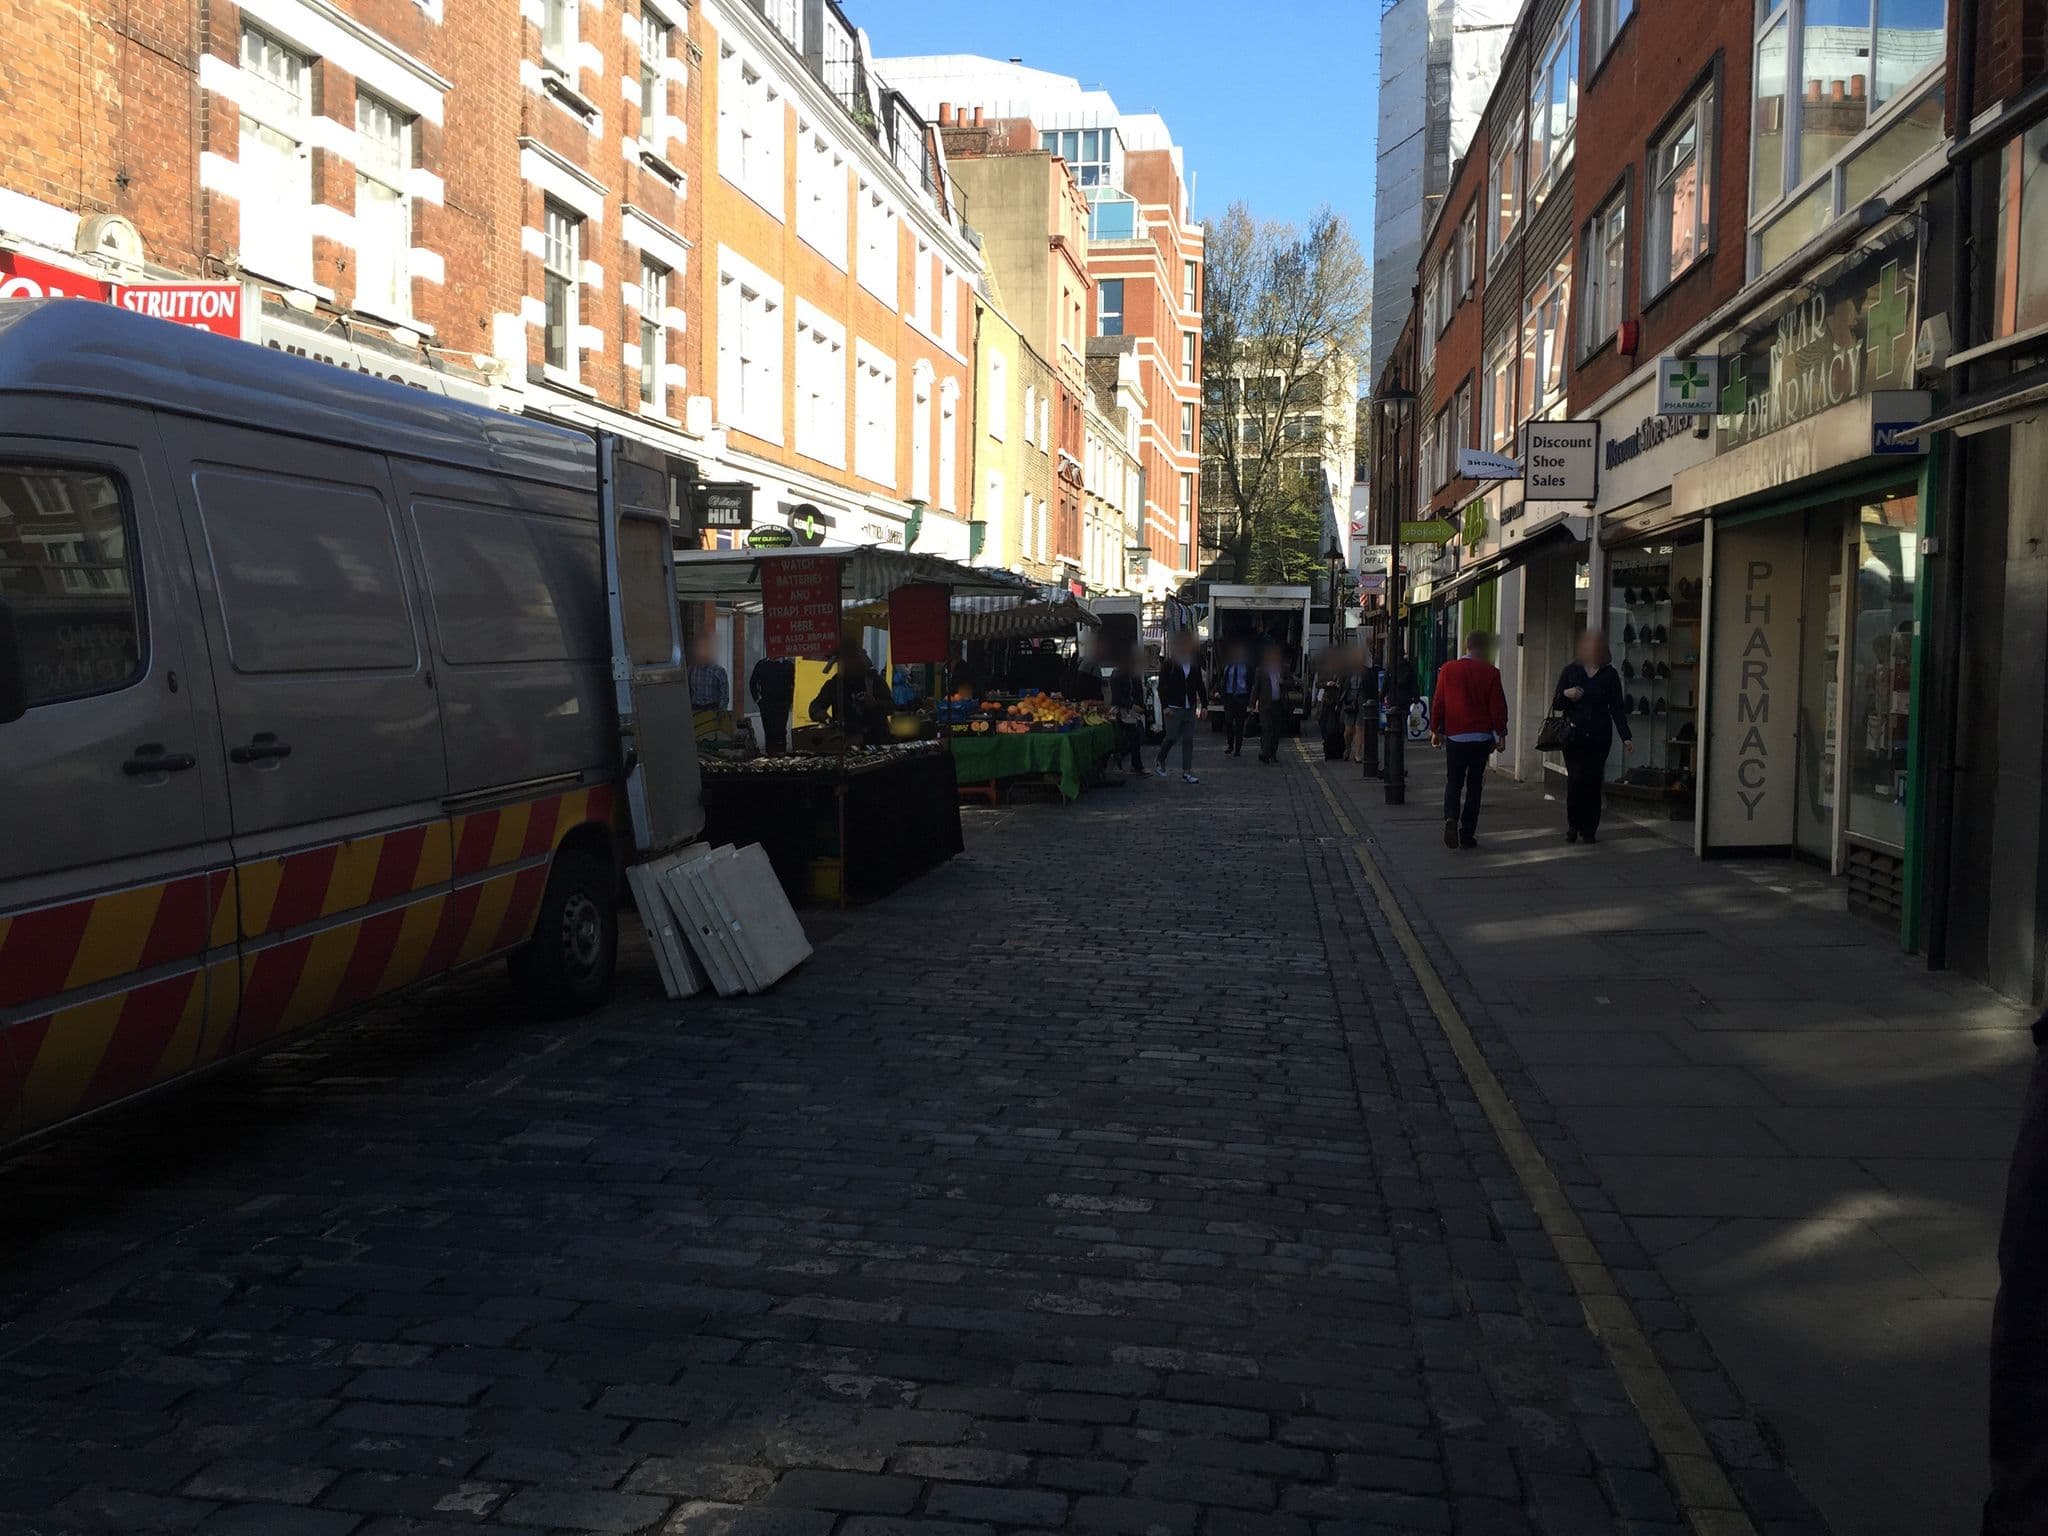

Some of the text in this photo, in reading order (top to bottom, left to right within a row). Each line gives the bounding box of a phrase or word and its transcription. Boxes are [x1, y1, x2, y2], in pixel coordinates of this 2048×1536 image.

[123, 290, 236, 318] STRUTTON
[1777, 292, 1826, 356] STAR
[1746, 338, 1863, 440] PHARMACY
[1664, 401, 1713, 409] PHARMACY
[1533, 435, 1592, 449] Discount
[1533, 454, 1565, 467] Shoe
[1533, 474, 1565, 487] Sales
[708, 509, 741, 524] HILL
[1364, 548, 1405, 556] Costcur
[781, 559, 815, 570] WATCH
[1364, 556, 1377, 564] OFF
[776, 574, 822, 586] BATTERIES
[791, 589, 810, 601] AND
[769, 604, 833, 617] STRAPS FITTED
[790, 620, 815, 631] HERE
[785, 634, 804, 642] ALSO
[1737, 560, 1772, 821] PHARMACY
